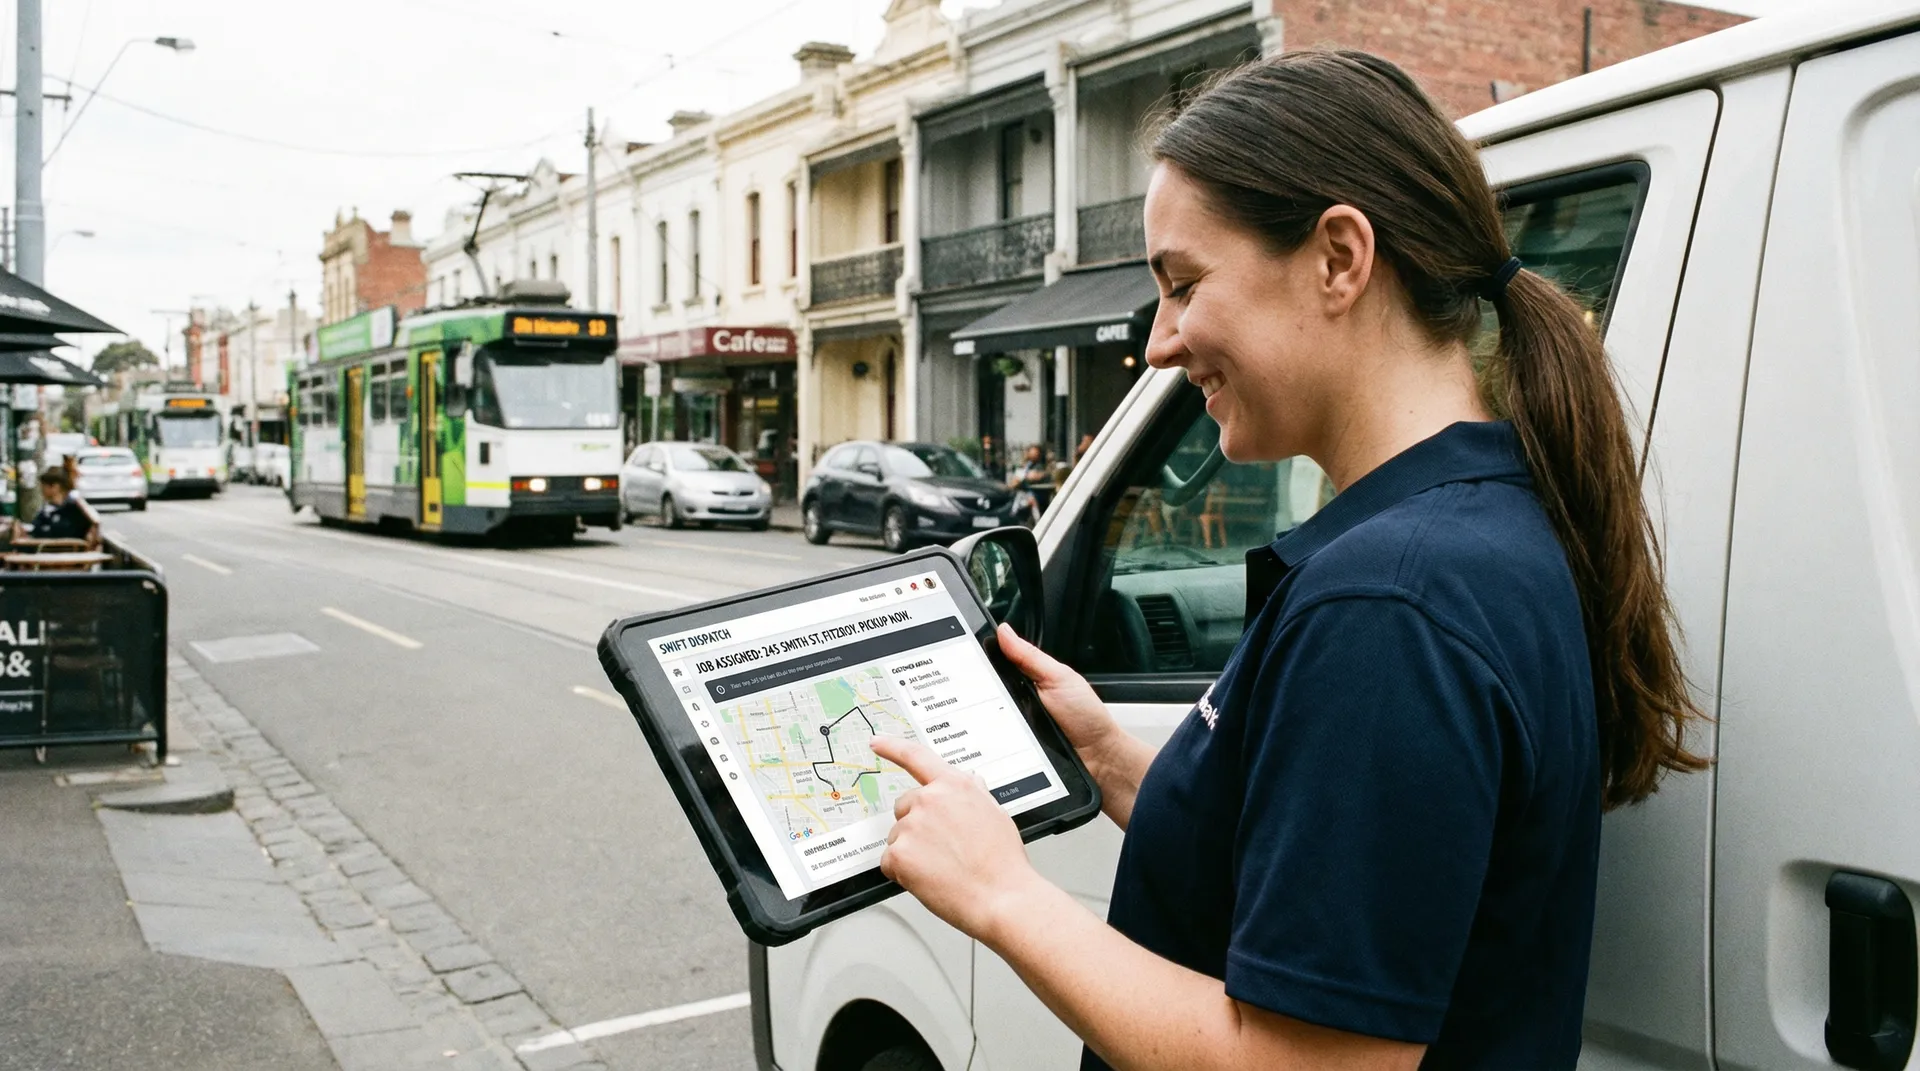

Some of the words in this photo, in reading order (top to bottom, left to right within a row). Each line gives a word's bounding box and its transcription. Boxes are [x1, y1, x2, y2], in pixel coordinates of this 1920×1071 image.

[712, 329, 766, 353] Cafe
[659, 639, 687, 655] SWIFT
[688, 628, 732, 648] DISPATCH
[695, 660, 715, 674] JOB
[716, 648, 763, 669] ASSIGNED:
[761, 643, 780, 657] 245
[780, 636, 809, 653] SMITH
[809, 633, 824, 645] ST,
[859, 616, 888, 632] PICKUP
